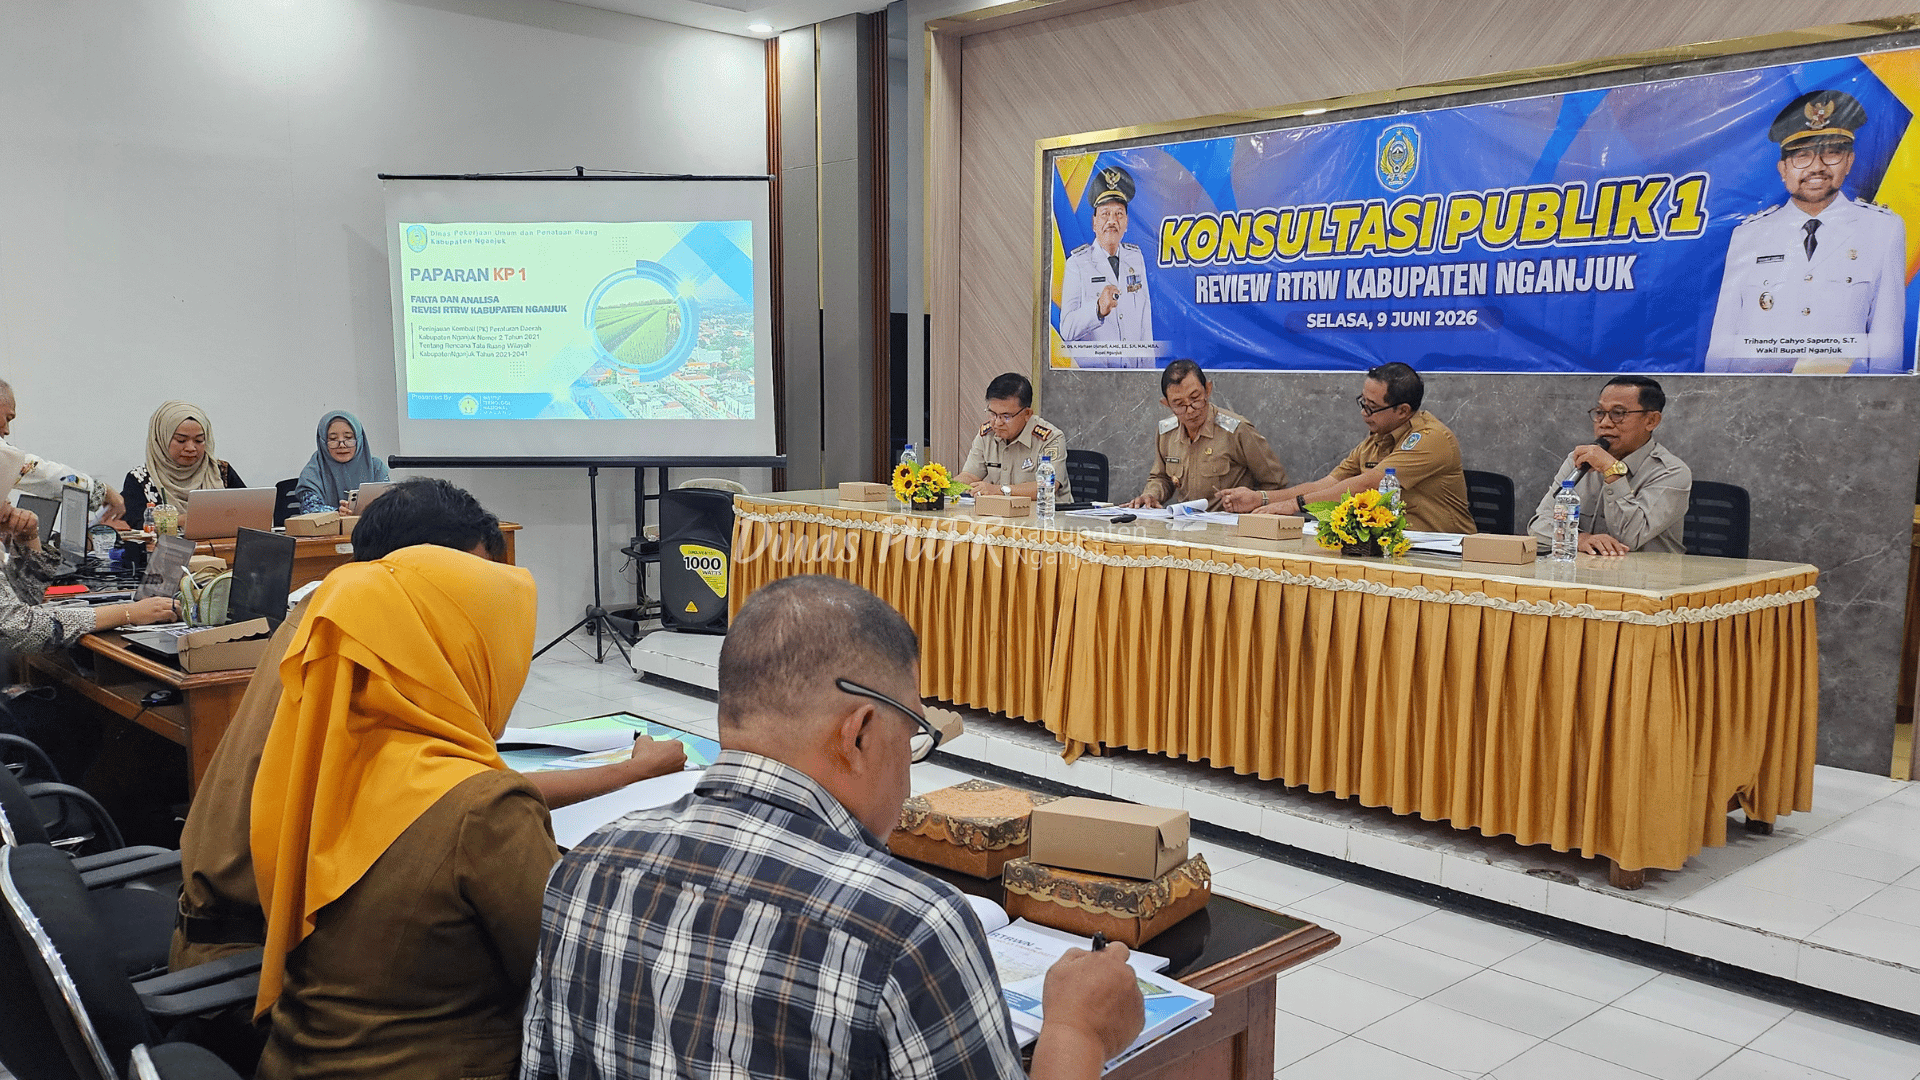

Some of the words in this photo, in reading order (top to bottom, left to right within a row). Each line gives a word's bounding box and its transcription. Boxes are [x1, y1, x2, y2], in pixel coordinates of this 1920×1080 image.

[1160, 196, 1438, 265] KONSULTASI
[1444, 176, 1670, 250] PUBLIK
[1666, 174, 1708, 237] 1
[454, 229, 492, 237] Pekerjaan
[431, 238, 472, 246] Kabupaten
[410, 268, 489, 282] PAPARAN
[493, 267, 515, 281] KP
[518, 267, 526, 281] 1
[1195, 273, 1272, 304] REVIEW
[1276, 269, 1341, 302] RTRW
[1346, 262, 1488, 300] KABUPATEN
[1495, 255, 1638, 295] NGANJUK
[411, 295, 438, 303] FAKTA
[440, 295, 459, 303] DAN
[461, 295, 500, 303] ANALISA
[411, 306, 441, 314] REVISI
[471, 305, 523, 314] KABUPATEN
[525, 305, 567, 313] NGANJUK
[1306, 312, 1373, 331] SELASA,
[1377, 311, 1388, 327] 9
[1391, 310, 1431, 327] JUNI
[1434, 309, 1478, 326] 2026
[419, 325, 450, 333] Peninjauan
[420, 342, 443, 350] Tentang
[684, 556, 722, 570] 1000
